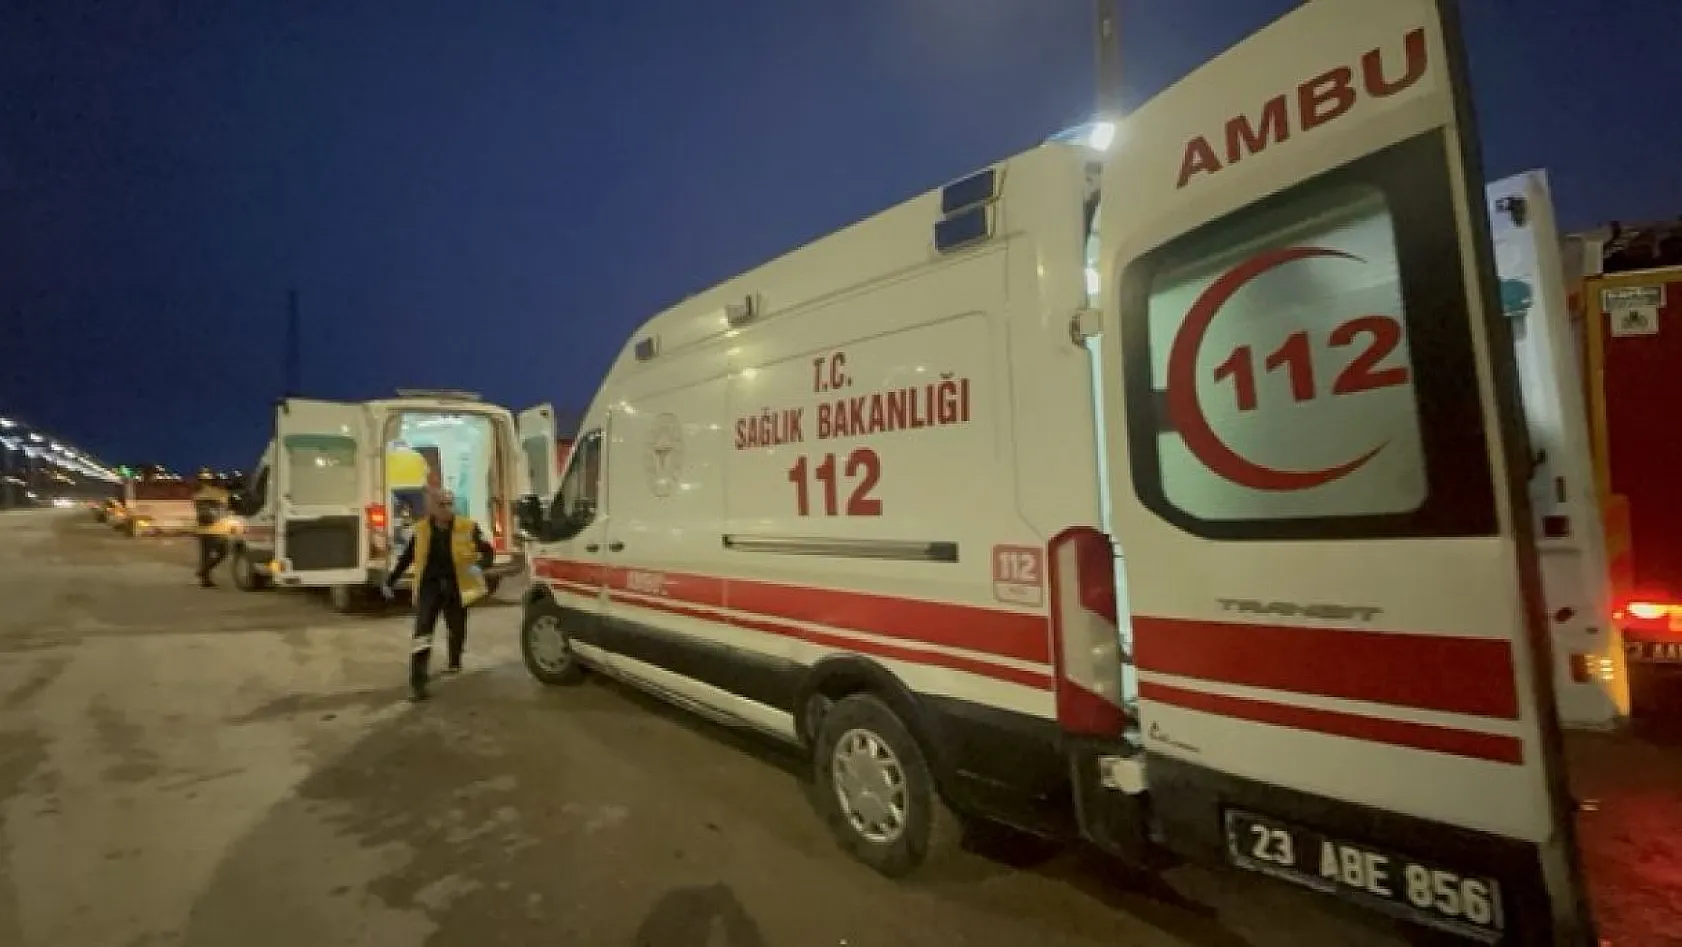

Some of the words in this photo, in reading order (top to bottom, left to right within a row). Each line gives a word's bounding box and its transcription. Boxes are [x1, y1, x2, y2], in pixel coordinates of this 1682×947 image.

[1177, 27, 1428, 189] AMBU
[813, 352, 853, 392] T.C.
[1213, 315, 1410, 411] 112
[735, 407, 804, 450] SAĞLIK
[817, 372, 970, 439] BAKANLIĞI
[788, 447, 883, 516] 112
[999, 551, 1037, 582] 112
[1250, 824, 1294, 865] 23
[1320, 841, 1393, 897] ABE
[1405, 863, 1492, 924] 856
